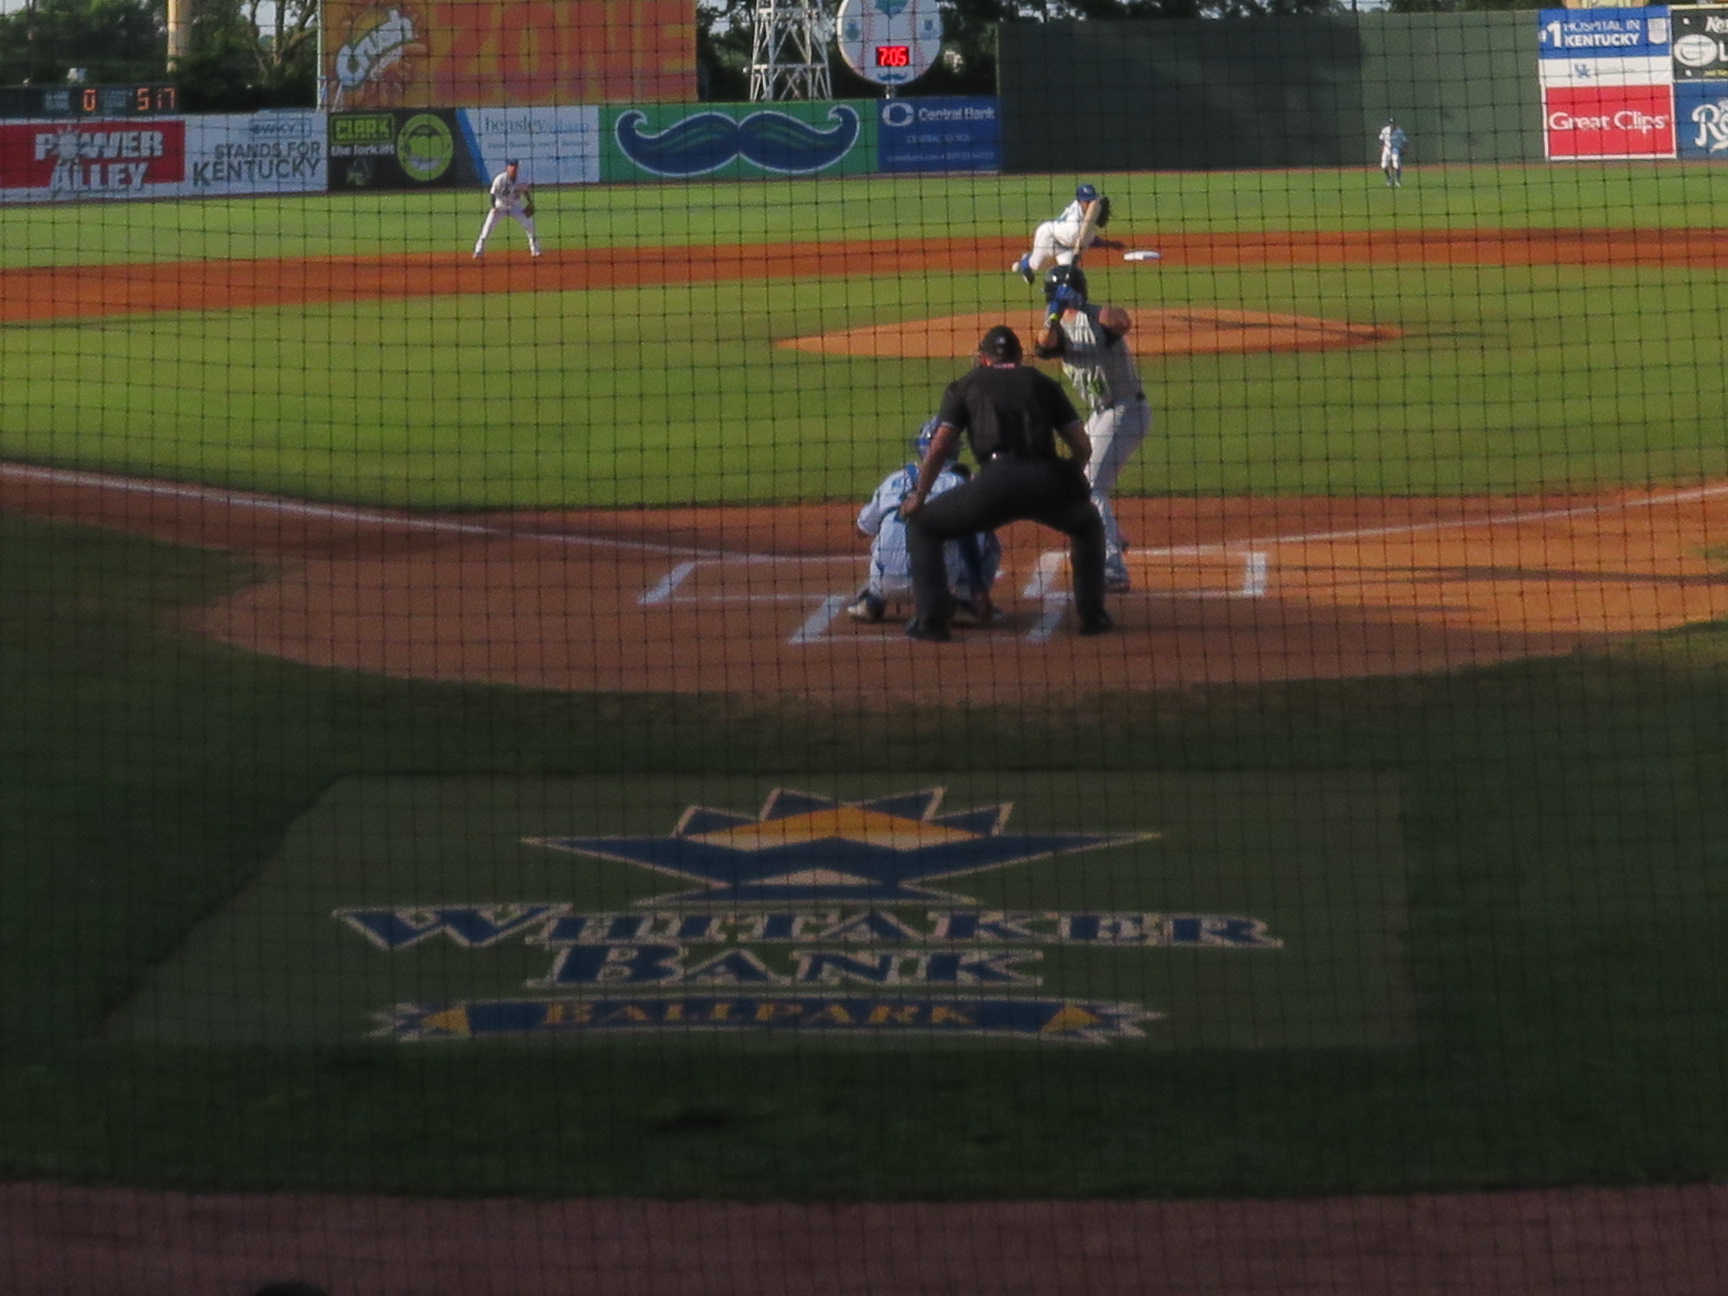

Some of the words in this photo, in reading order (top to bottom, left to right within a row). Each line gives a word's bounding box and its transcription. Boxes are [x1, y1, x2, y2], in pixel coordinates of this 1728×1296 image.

[1564, 32, 1641, 47] KENTUCKY
[877, 47, 909, 66] 7:05
[82, 88, 96, 111] 0
[483, 116, 545, 134] hensley
[918, 107, 963, 122] Central
[964, 106, 997, 121] Bank
[1549, 112, 1611, 134] Great
[1613, 109, 1666, 136] Clips
[214, 141, 283, 161] STANDS
[286, 140, 321, 157] FOR
[330, 144, 351, 157] the
[353, 143, 395, 156] forklift
[49, 160, 151, 192] ALLEY
[192, 157, 320, 188] KENTUCKY
[329, 900, 1285, 951] WHITAKER
[522, 943, 1045, 989] BANK
[541, 1000, 982, 1029] BALLPARK
